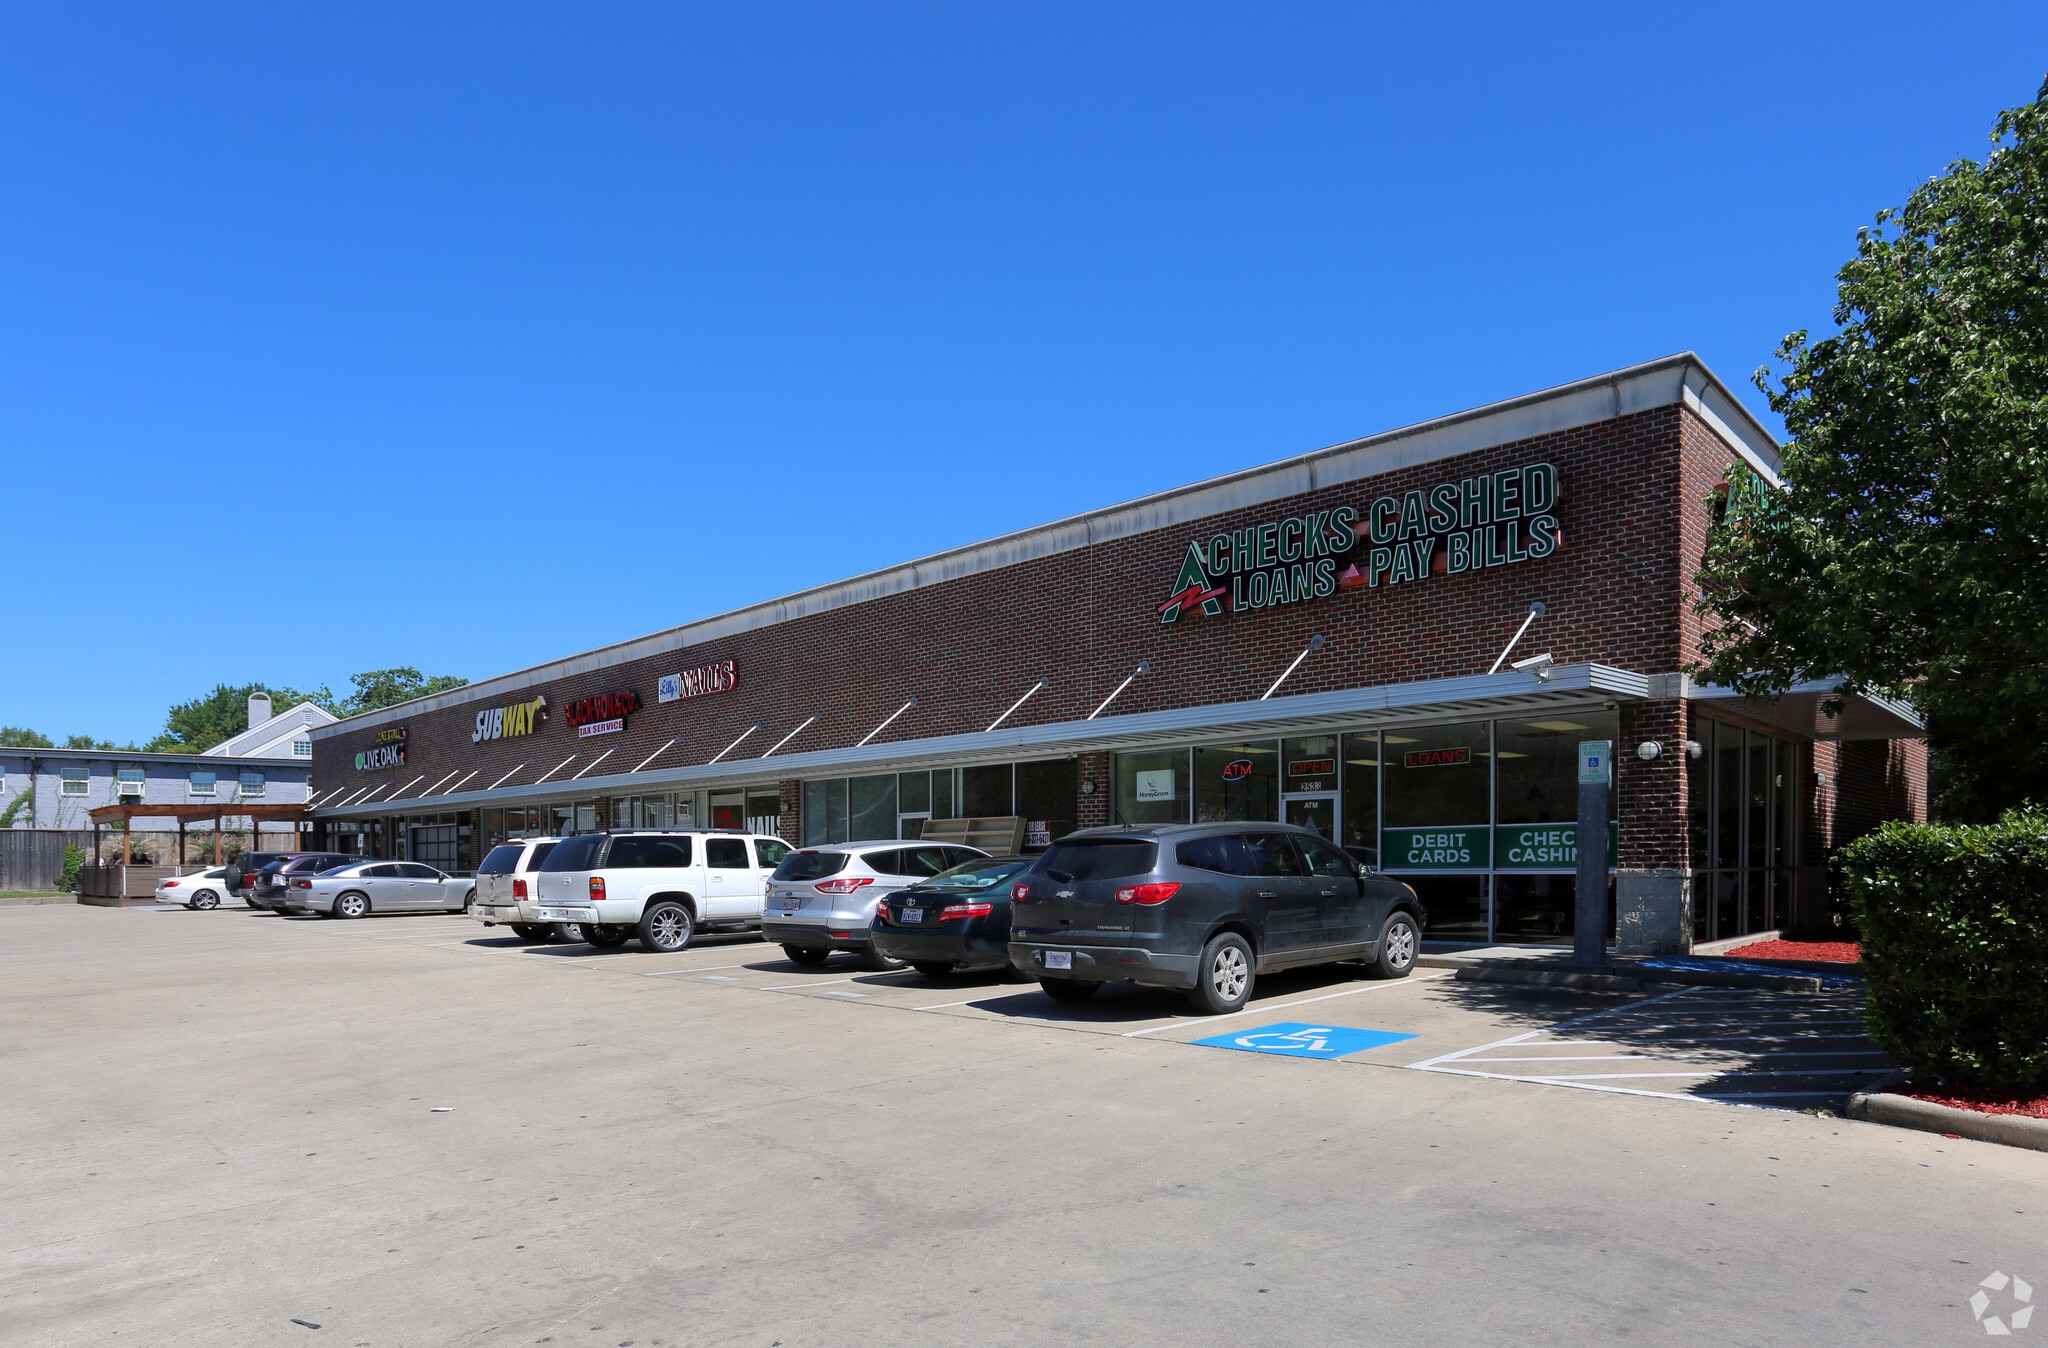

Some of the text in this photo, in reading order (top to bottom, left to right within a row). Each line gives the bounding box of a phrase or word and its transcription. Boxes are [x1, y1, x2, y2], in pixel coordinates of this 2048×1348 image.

[1207, 463, 1557, 577] CHECKS CASHED
[1233, 515, 1560, 613] LOANS PAY BILLS
[678, 661, 737, 699] NAILS
[472, 696, 546, 743] SUBWAY
[580, 721, 623, 736] TAX SERVICE
[380, 745, 398, 766] OAK
[1408, 749, 1467, 766] LOANS
[1223, 763, 1253, 776] ATM
[1292, 761, 1332, 774] OPEN
[1412, 833, 1466, 848] DEBIT
[1520, 831, 1575, 846] CHEC
[1408, 849, 1471, 864] CARDS
[1509, 847, 1578, 863] CASHI
